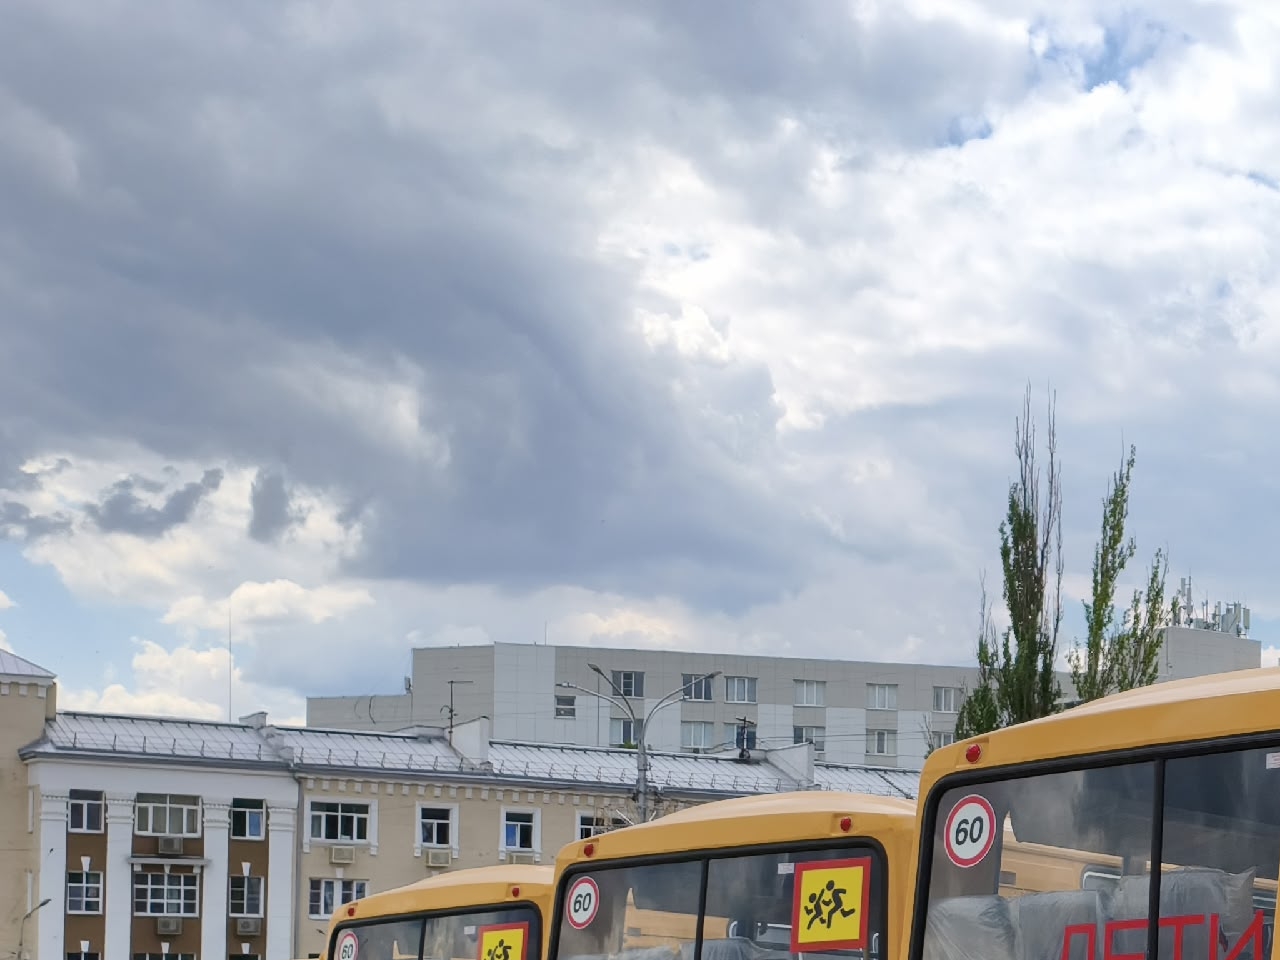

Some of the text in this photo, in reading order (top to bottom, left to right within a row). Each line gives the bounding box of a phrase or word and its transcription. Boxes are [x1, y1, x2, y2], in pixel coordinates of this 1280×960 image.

[955, 816, 984, 846] 60
[573, 892, 592, 914] 60
[341, 943, 354, 960] 60
